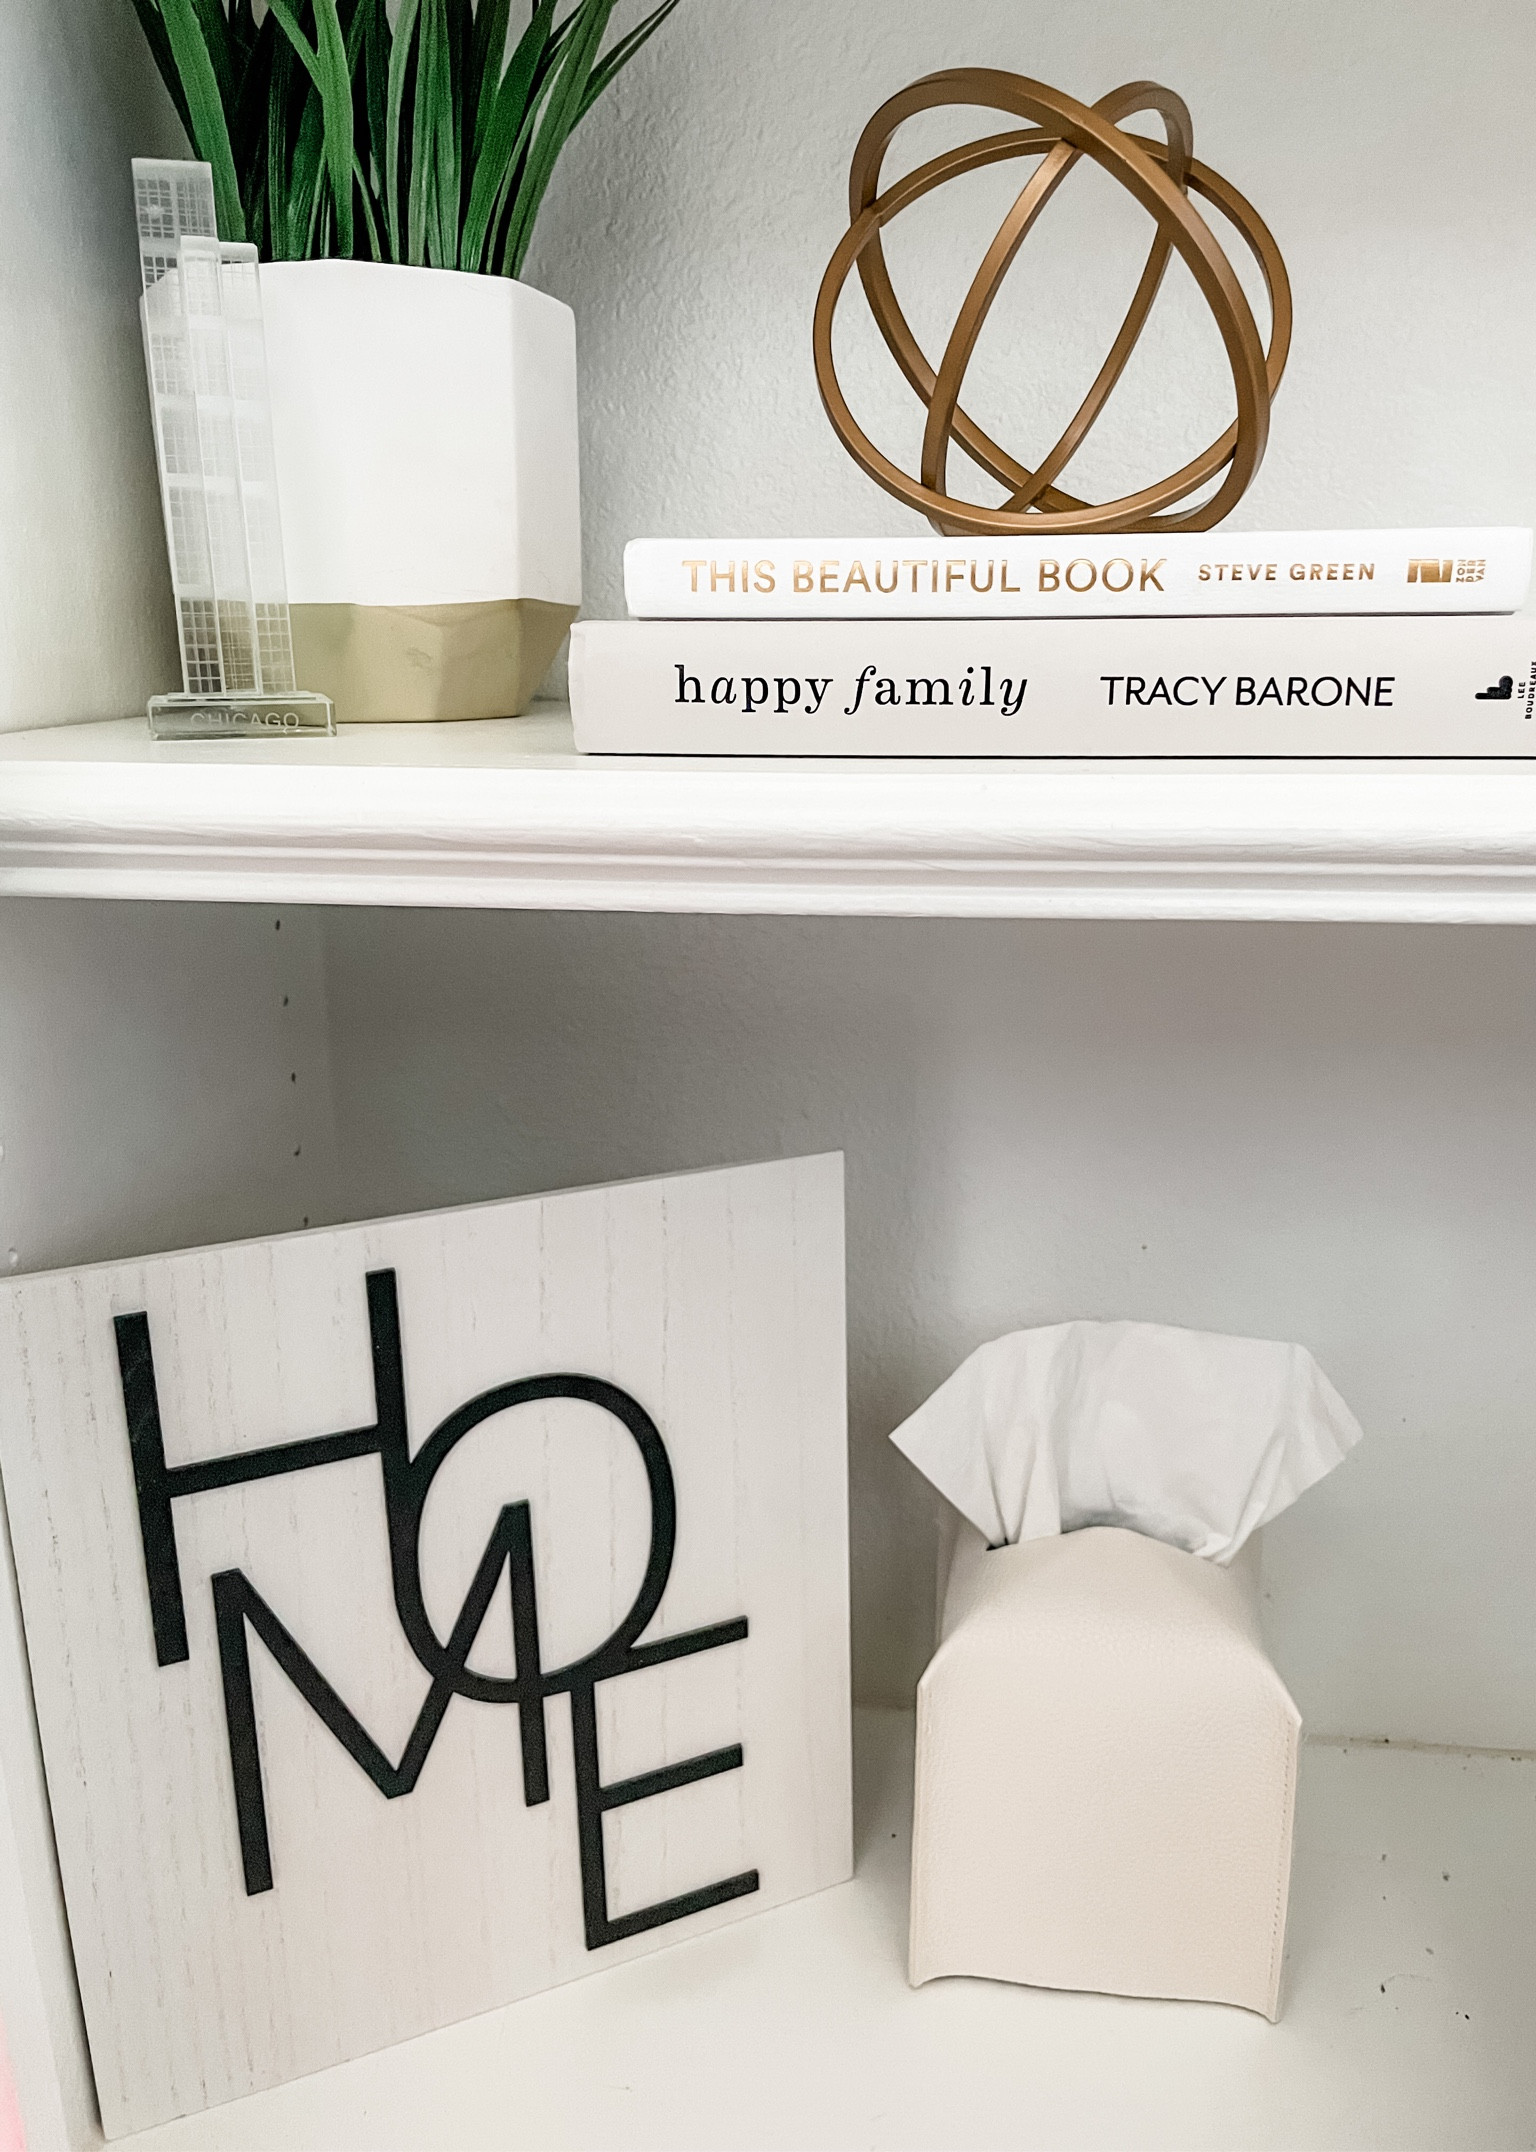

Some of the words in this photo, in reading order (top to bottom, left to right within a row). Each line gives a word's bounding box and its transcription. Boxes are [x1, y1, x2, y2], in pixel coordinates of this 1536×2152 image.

[682, 560, 776, 593] THIS
[793, 559, 1020, 593] BEAUTIFUL
[1038, 558, 1167, 592] BOOK
[1198, 563, 1277, 582] STEVE
[1289, 563, 1375, 582] GREEN
[674, 664, 833, 714] happy
[844, 665, 1028, 717] family
[1100, 676, 1227, 706] TRACY
[1235, 676, 1396, 707] BARONE
[1517, 681, 1526, 699] LEE
[190, 712, 300, 730] CHICAGO
